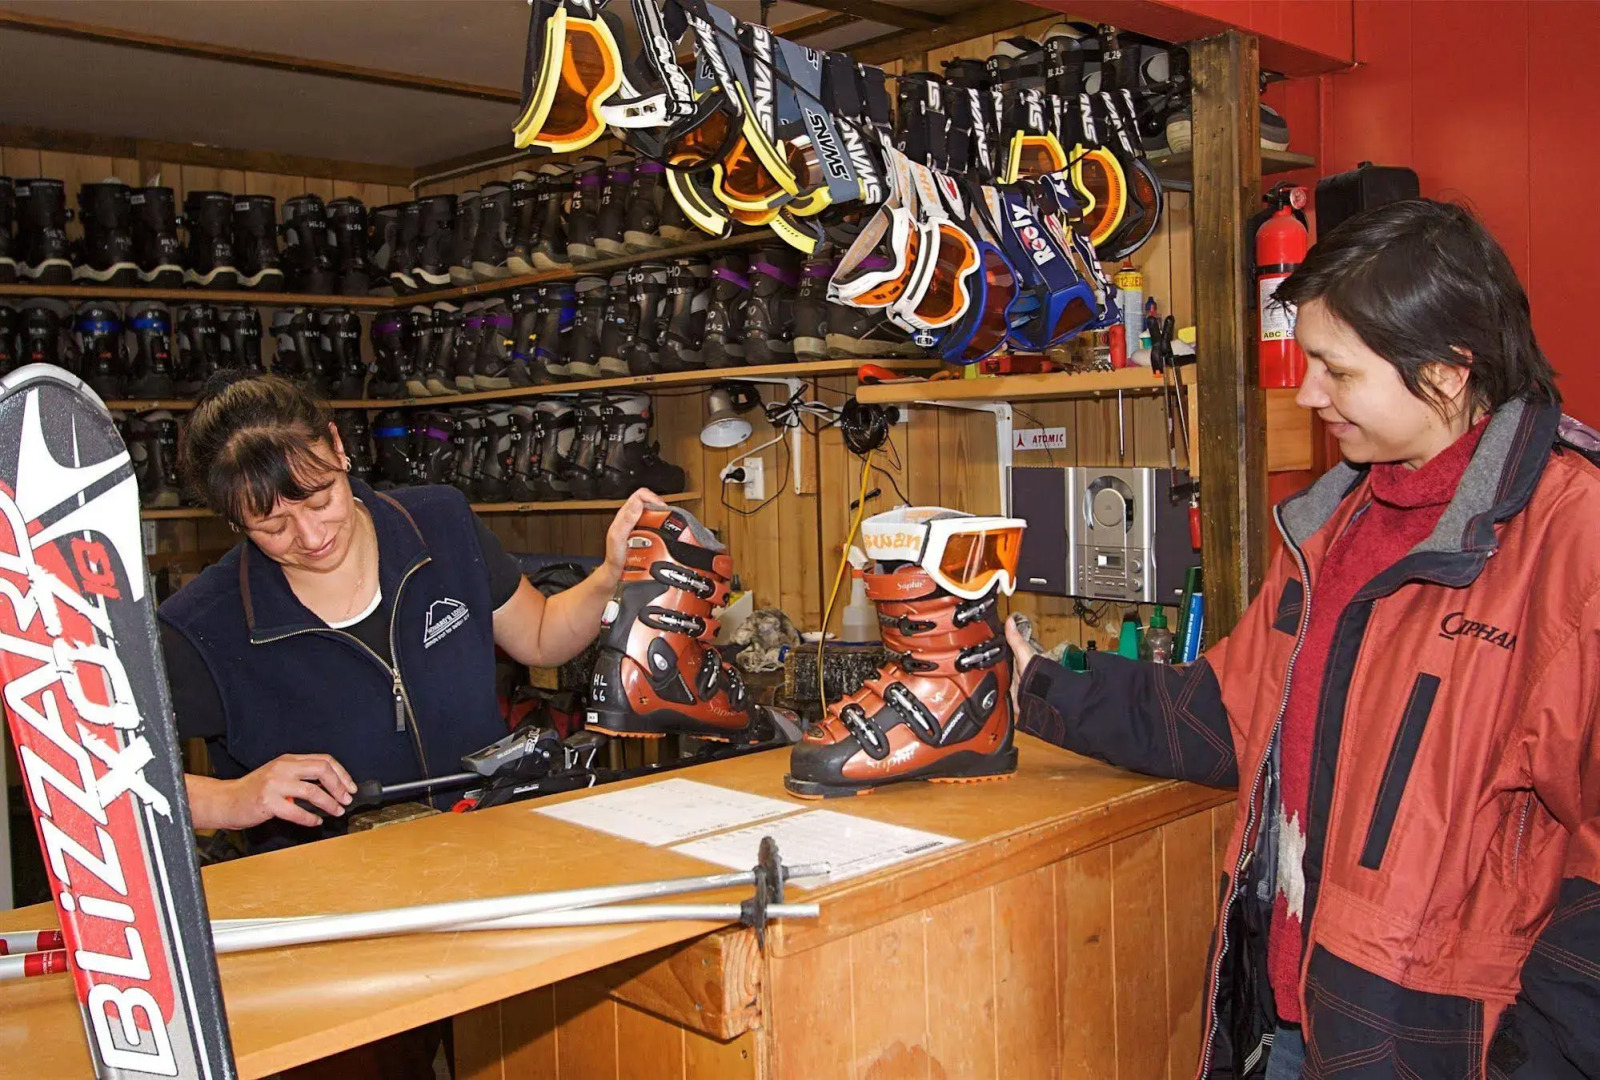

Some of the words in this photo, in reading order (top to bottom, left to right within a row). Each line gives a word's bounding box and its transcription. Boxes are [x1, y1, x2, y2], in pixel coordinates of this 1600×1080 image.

[753, 26, 778, 147] SWANS
[805, 107, 851, 181] SWANS
[1032, 434, 1064, 444] ATOMIC
[593, 674, 608, 688] HL
